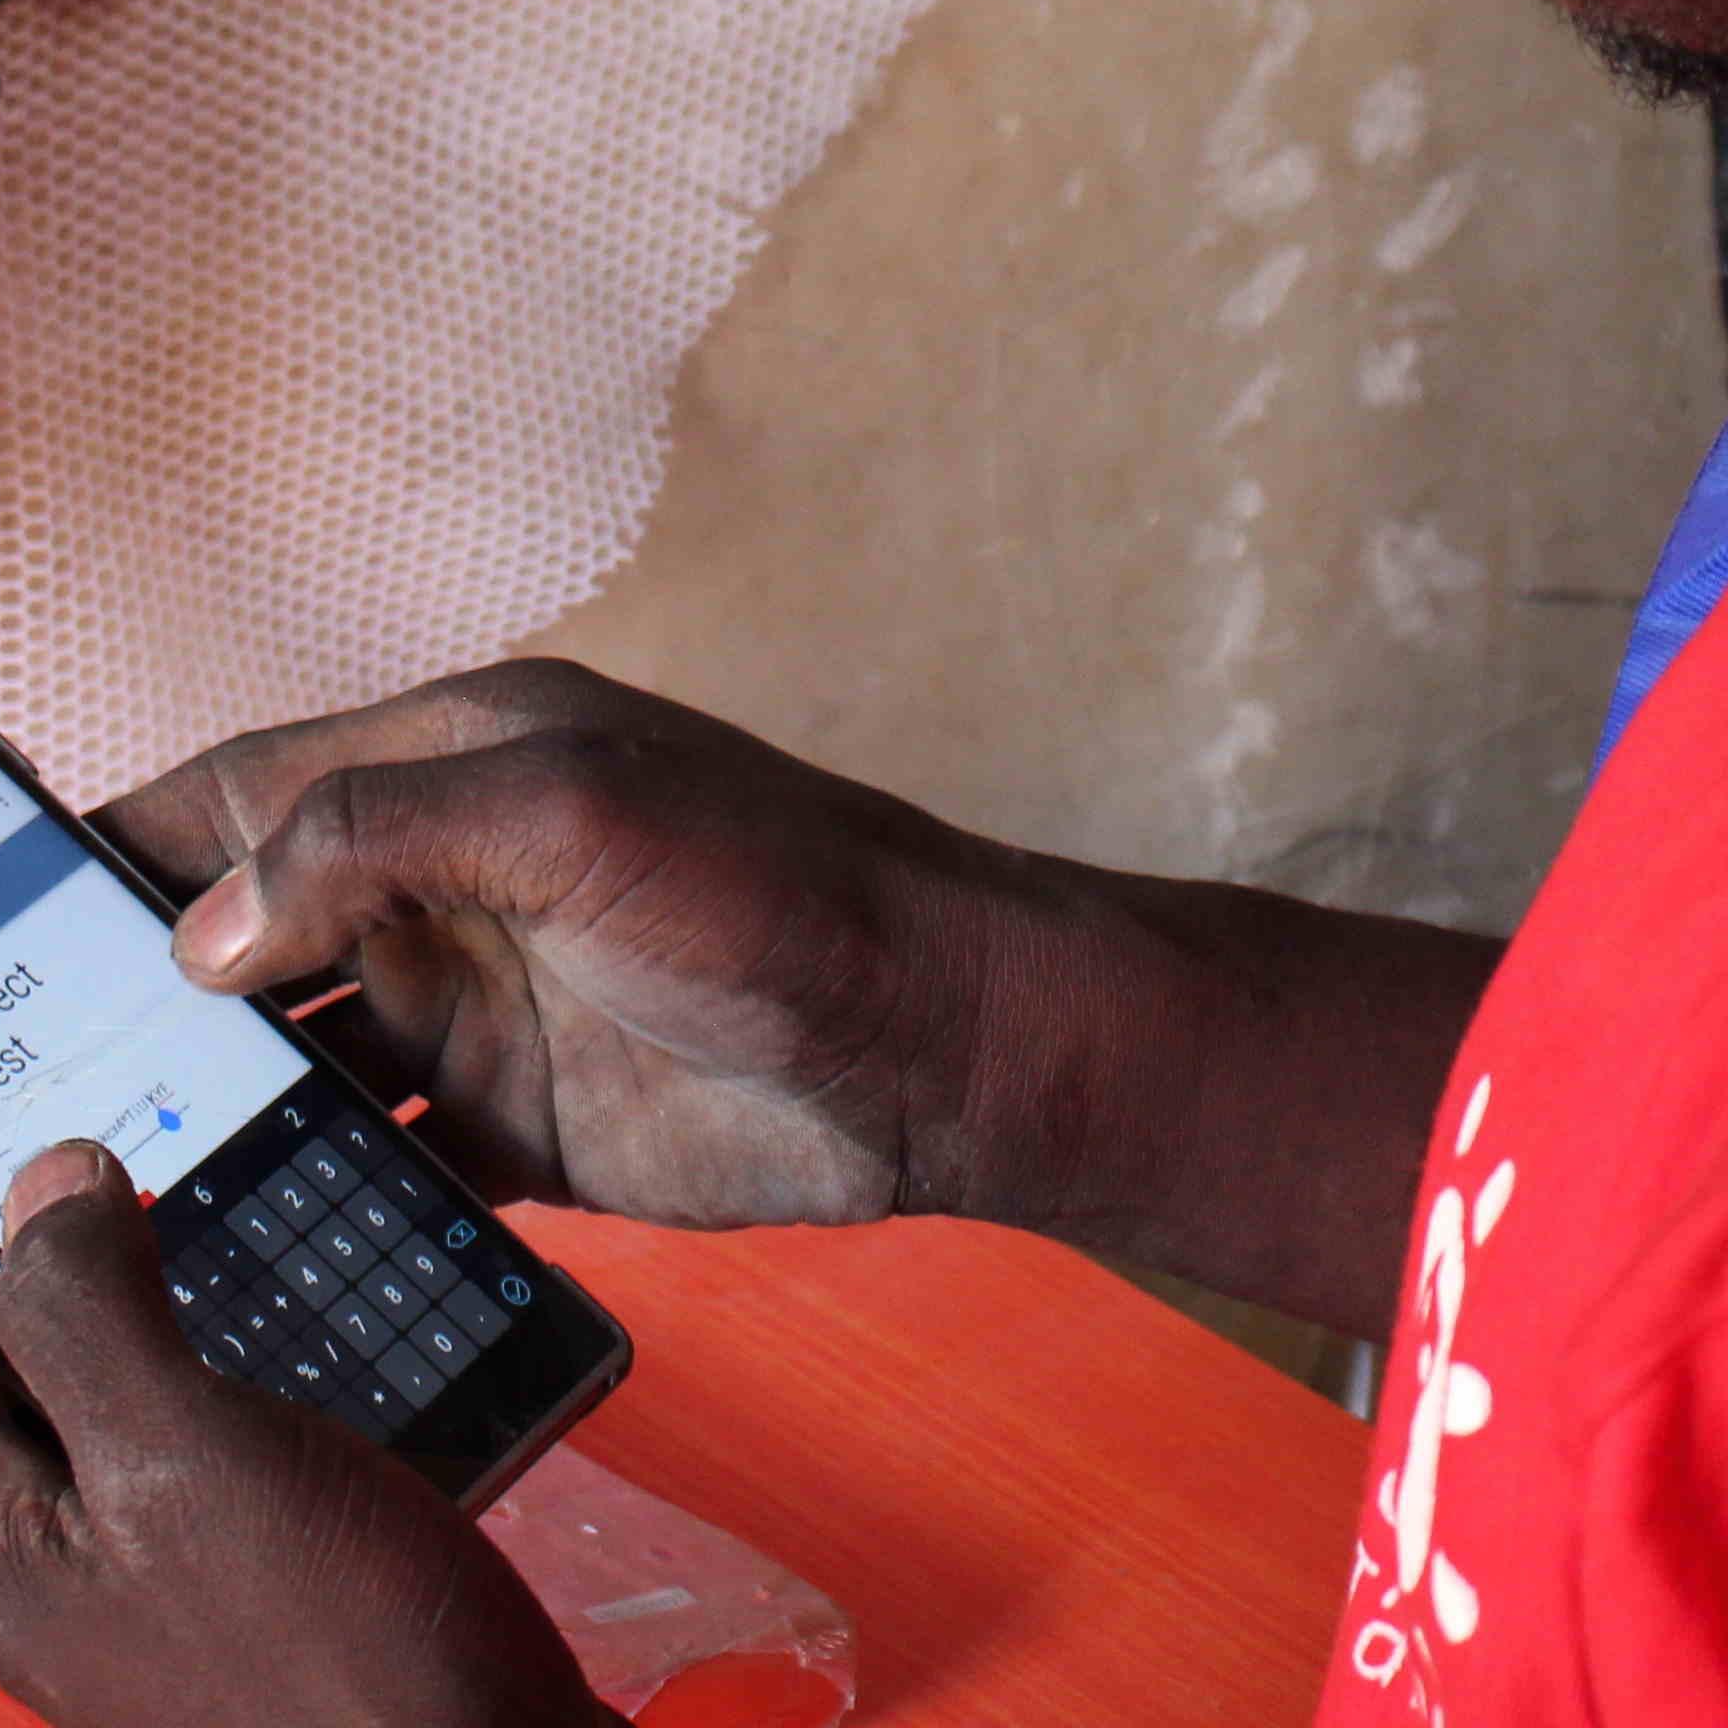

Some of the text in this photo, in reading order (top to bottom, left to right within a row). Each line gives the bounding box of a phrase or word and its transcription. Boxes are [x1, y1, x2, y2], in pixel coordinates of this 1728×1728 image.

[193, 1107, 306, 1205] 6 2
[250, 1217, 270, 1236] 1
[283, 1188, 305, 1210] 2
[316, 1159, 336, 1181] 3
[300, 1266, 320, 1287] 4
[332, 1235, 353, 1257] 5
[367, 1207, 386, 1228] 6
[348, 1313, 368, 1336] 7
[383, 1284, 403, 1305] 8
[416, 1255, 435, 1276] 9
[433, 1332, 454, 1354] 0
